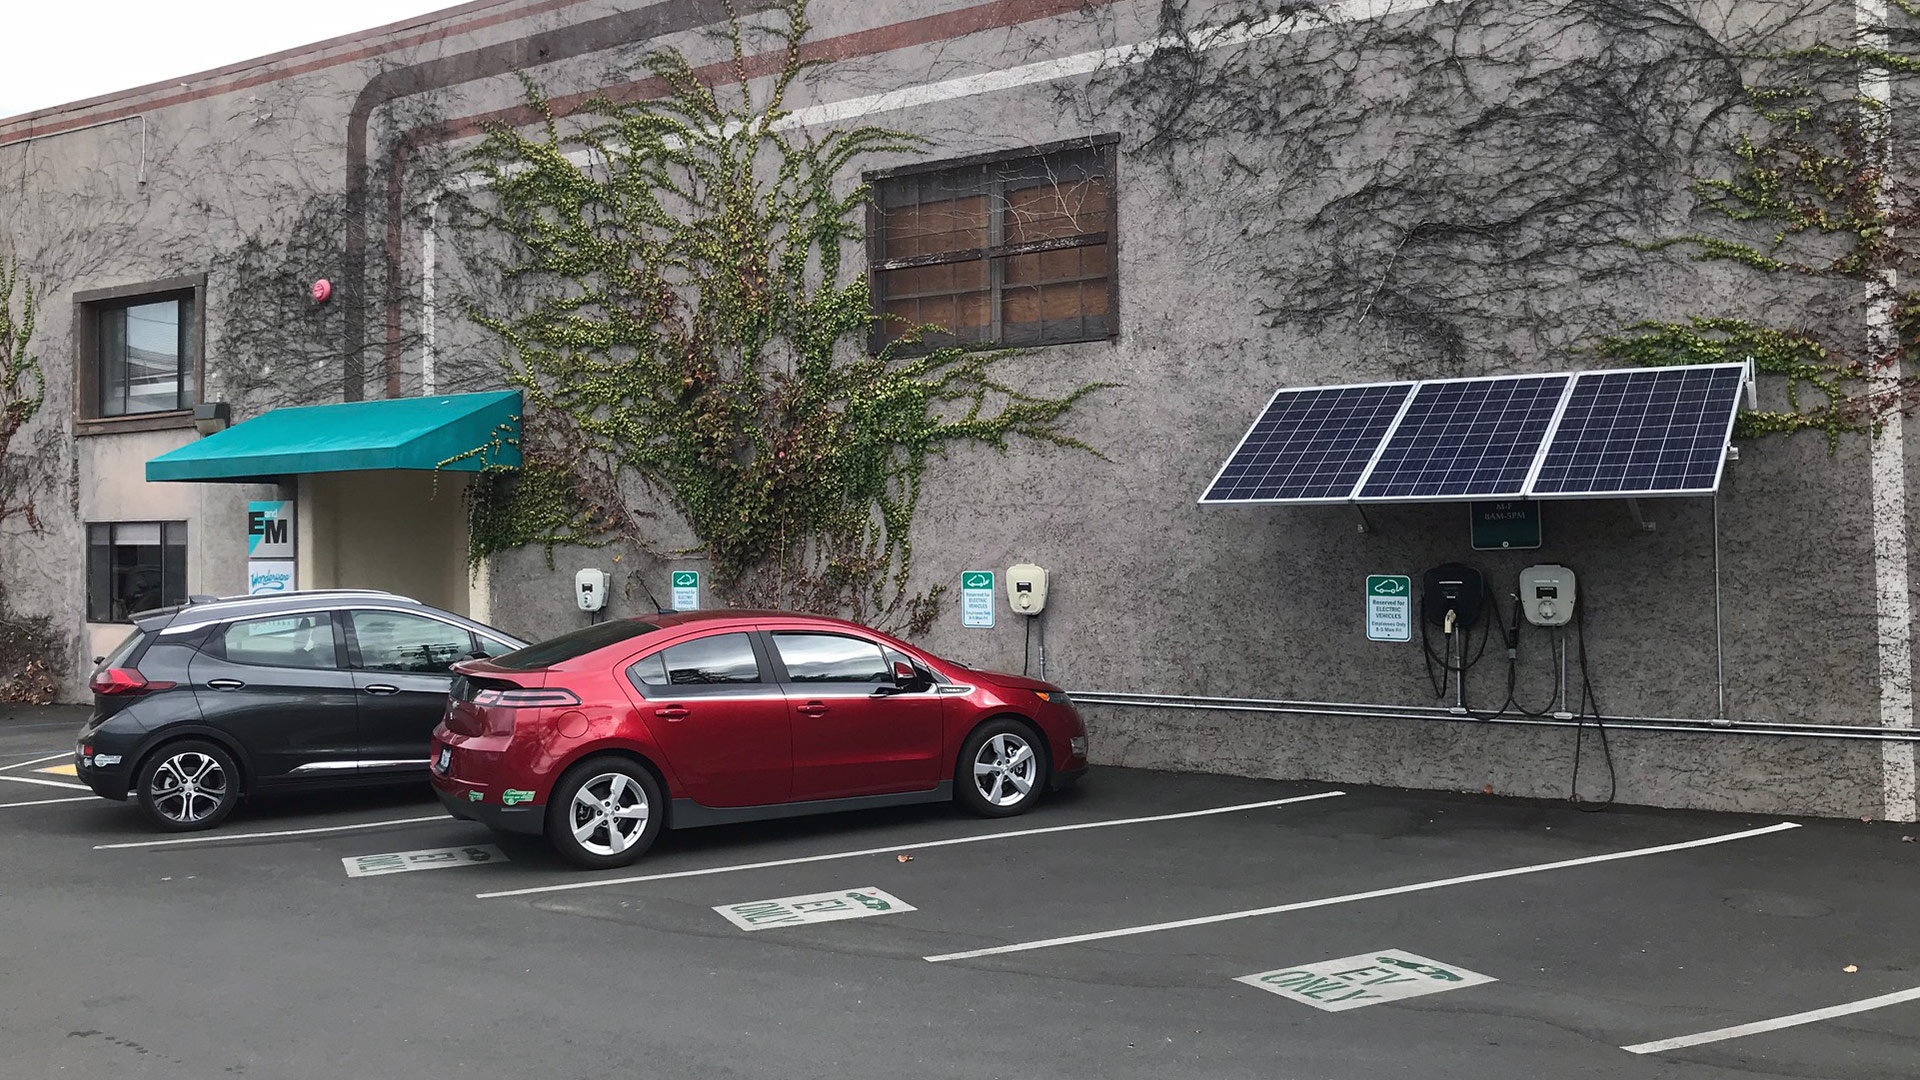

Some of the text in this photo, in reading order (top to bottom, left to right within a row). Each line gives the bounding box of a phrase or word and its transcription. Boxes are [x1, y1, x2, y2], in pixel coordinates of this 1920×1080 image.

[249, 509, 288, 544] E and M
[730, 902, 805, 926] ONLY
[791, 899, 854, 914] EV
[1260, 971, 1382, 1003] ONLY
[1331, 966, 1418, 985] EV
